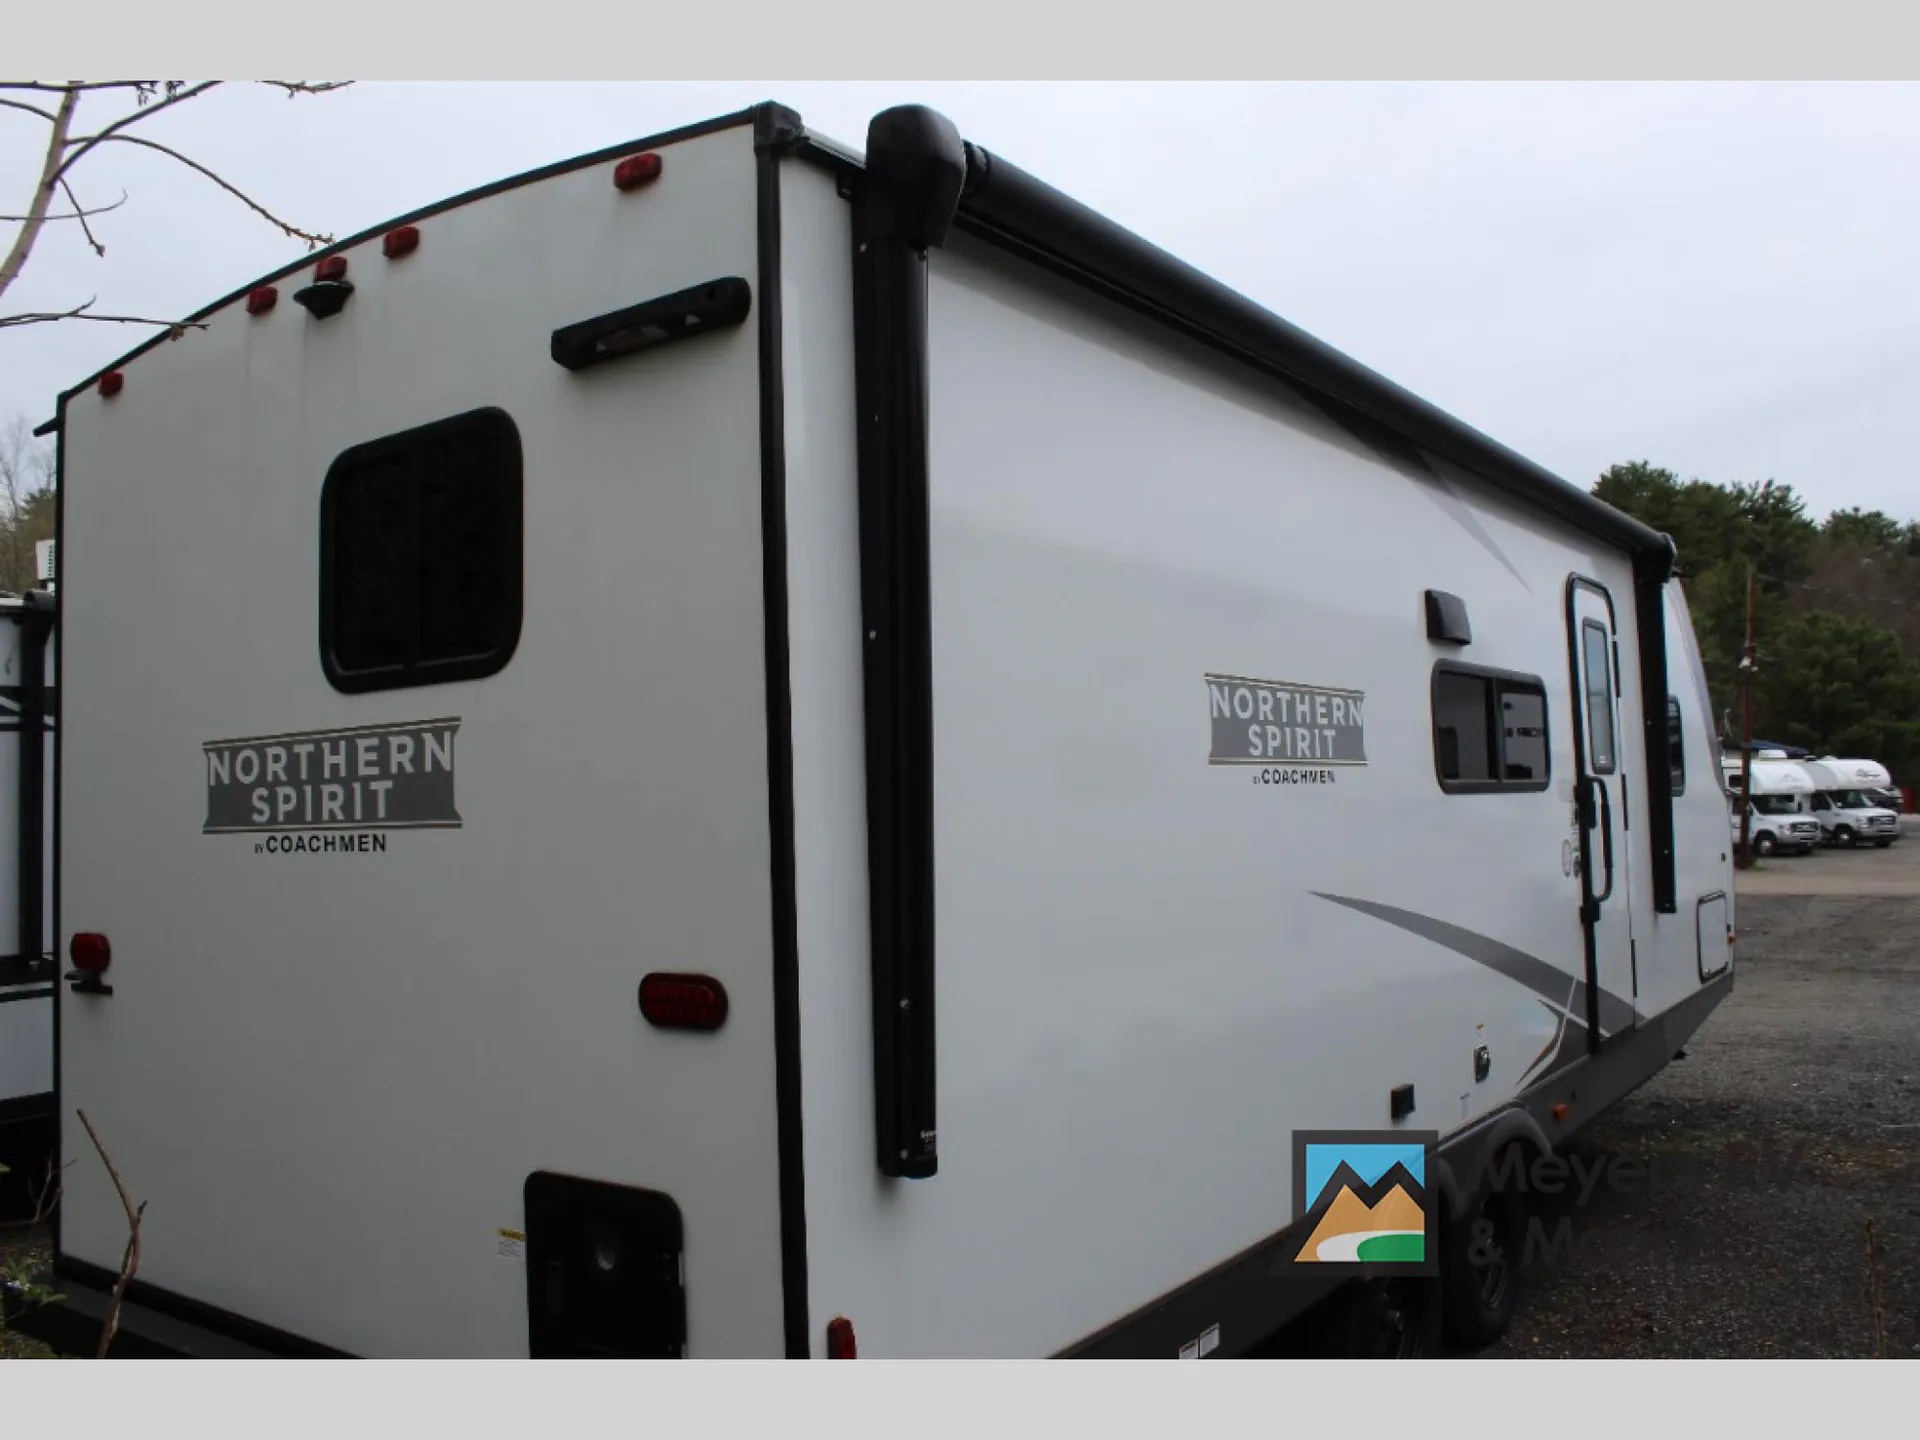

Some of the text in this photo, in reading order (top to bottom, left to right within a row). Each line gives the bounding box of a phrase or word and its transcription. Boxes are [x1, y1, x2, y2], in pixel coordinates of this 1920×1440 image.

[1209, 684, 1364, 727] NORTHERN
[207, 731, 453, 786] NORTHERN
[1248, 723, 1336, 758] SPIRIT
[1261, 769, 1336, 785] COACHMEN
[251, 780, 394, 823] SPIRIT
[265, 833, 387, 854] COACHMEN
